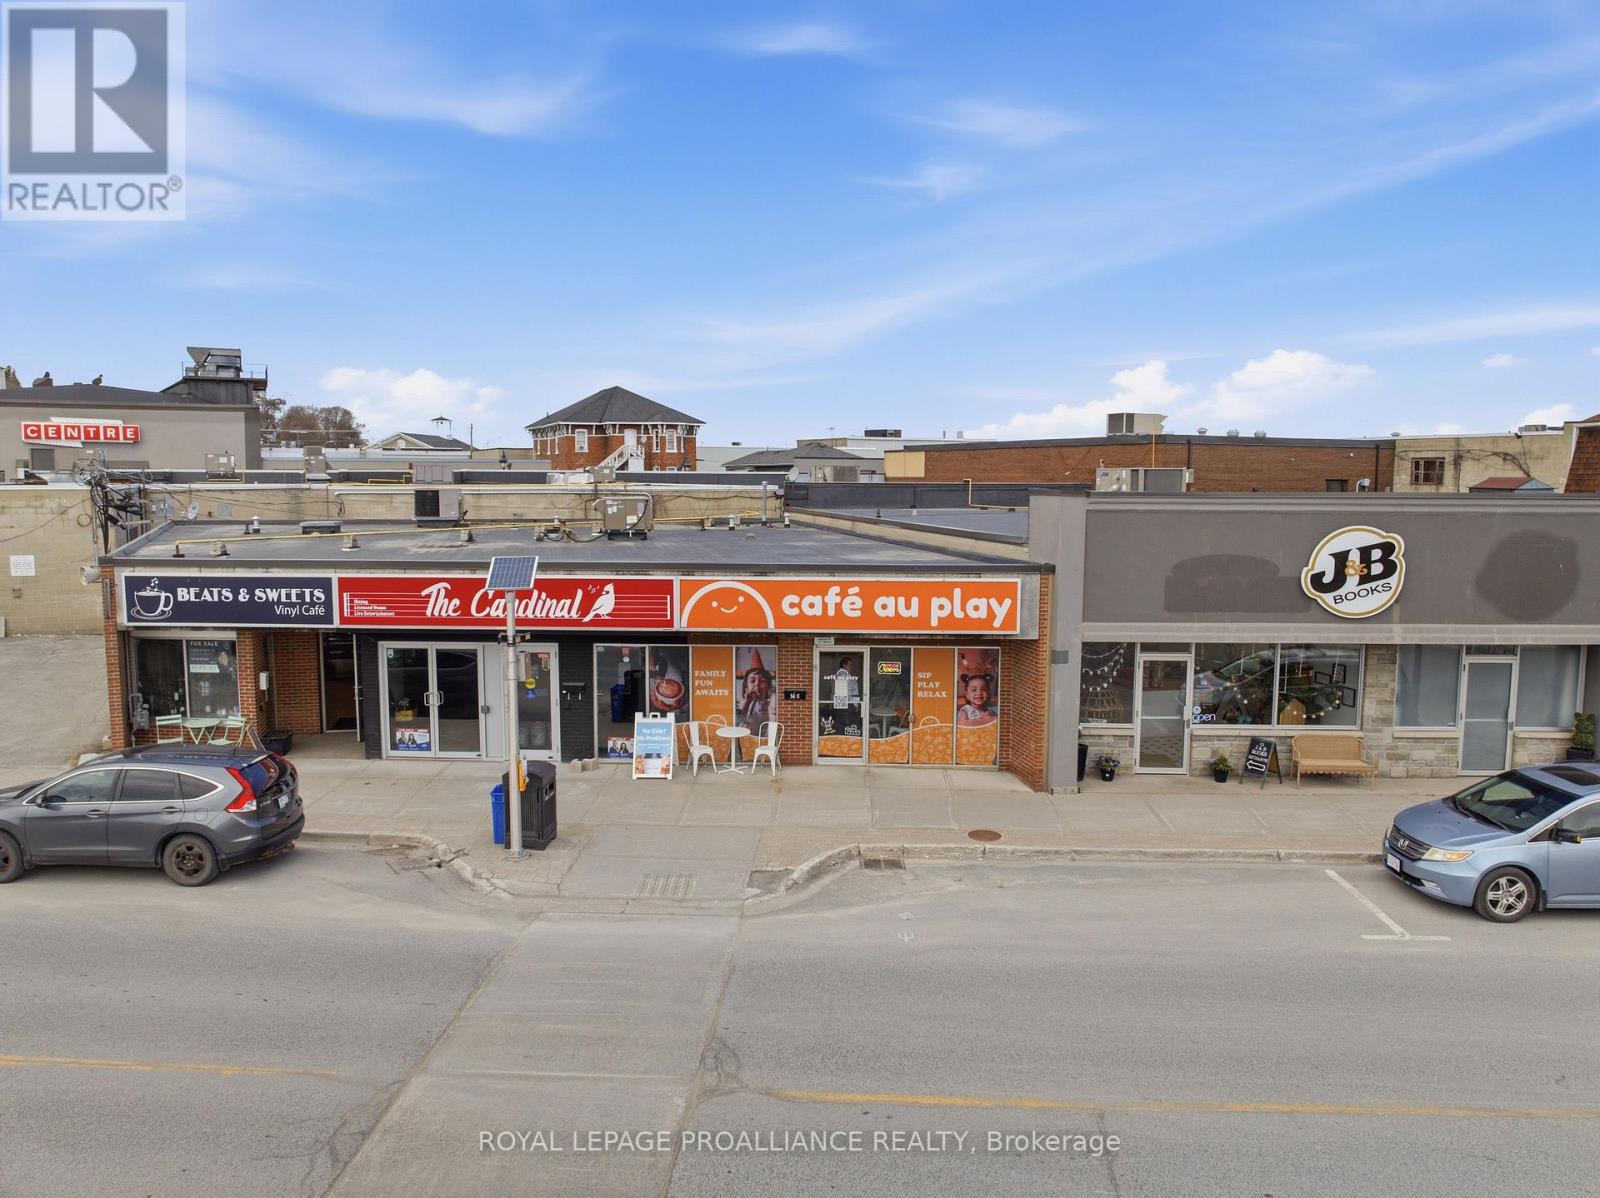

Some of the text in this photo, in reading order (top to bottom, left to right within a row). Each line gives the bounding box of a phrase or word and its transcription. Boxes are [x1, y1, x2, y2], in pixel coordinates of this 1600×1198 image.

[27, 427, 135, 438] CENTRE
[176, 587, 325, 603] BEATS & SWEETS
[421, 582, 582, 619] The Cadinal
[1333, 582, 1392, 605] BOOKS
[274, 605, 325, 617] Vinyl Café
[781, 586, 1012, 628] café au play
[694, 689, 729, 697] AWAITS
[917, 690, 948, 698] RELAX
